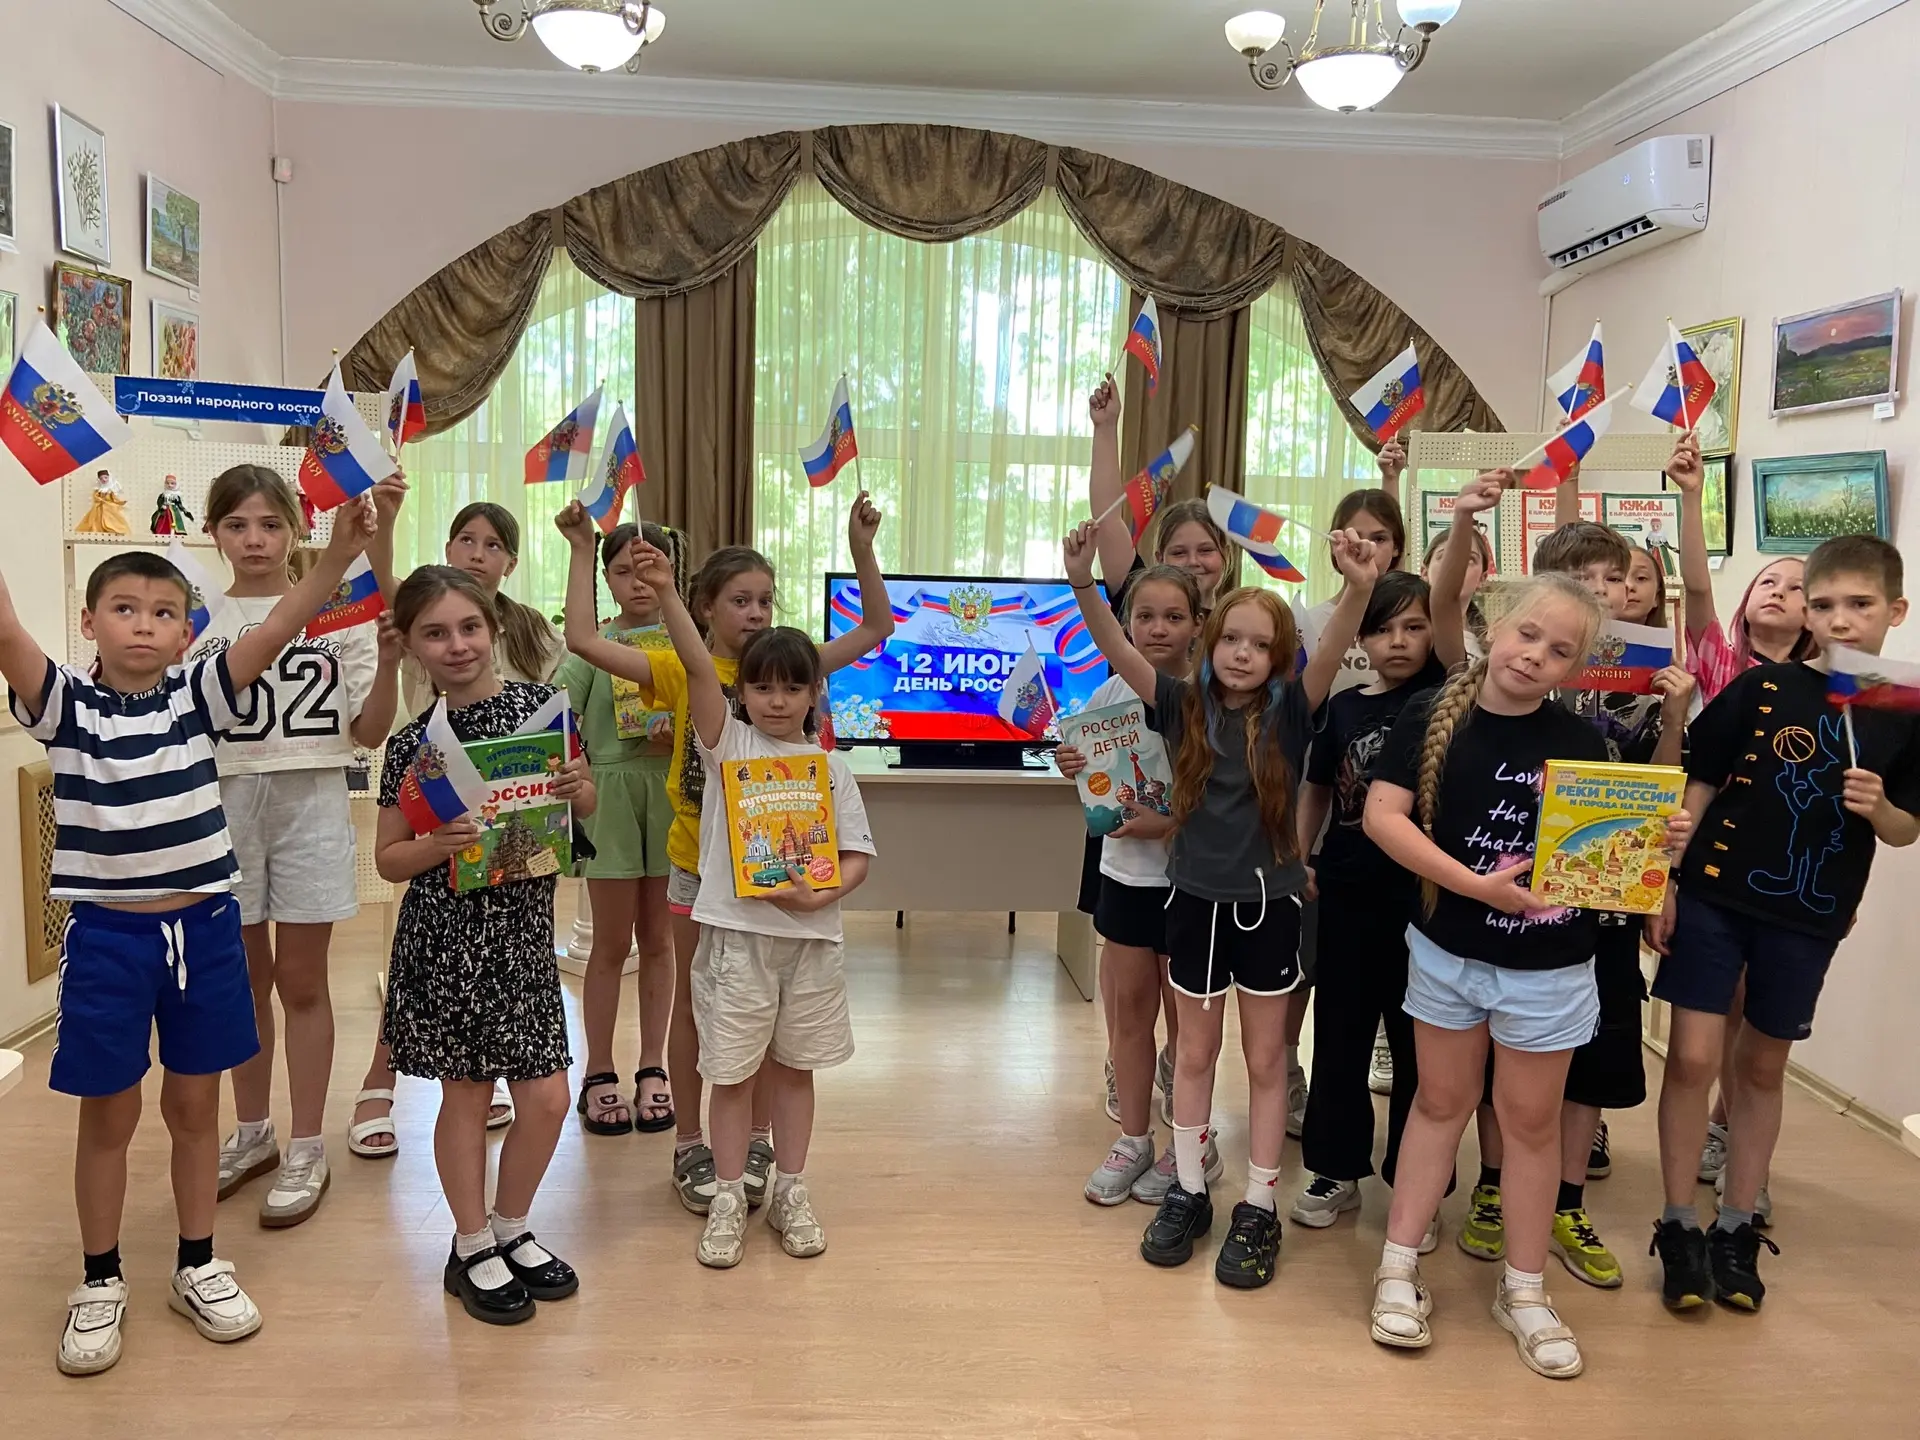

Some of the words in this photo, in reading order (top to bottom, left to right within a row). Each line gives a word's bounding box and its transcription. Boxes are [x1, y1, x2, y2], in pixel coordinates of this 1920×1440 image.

[138, 391, 192, 405] Поэзия
[195, 397, 274, 411] народного
[277, 402, 321, 415] костю
[1619, 500, 1663, 511] КУКЛЫ
[896, 653, 933, 674] 12
[944, 653, 1046, 675] ИЮН
[1582, 669, 1631, 679] РОССИЯ
[893, 676, 953, 693] ДЕНЬ
[960, 677, 1008, 692] РОС
[1081, 711, 1141, 737] РОССИЯ
[1093, 729, 1140, 757] ДЕТЕЙ
[1495, 763, 1543, 785] Lov
[741, 779, 816, 798] БОЛЬШОЕ
[1555, 784, 1600, 798] РЕКИ
[1605, 787, 1677, 803] РОССИИ
[1576, 778, 1610, 787] САМЫЕ
[1613, 780, 1660, 790] ГЛАВНЫЕ
[738, 790, 823, 809] путешествие
[766, 801, 818, 812] РОССИИ
[1579, 799, 1618, 809] ГОРОДА
[1620, 802, 1634, 810] НА
[1637, 803, 1658, 812] НИХ
[1488, 799, 1529, 825] the
[1465, 826, 1523, 851] that
